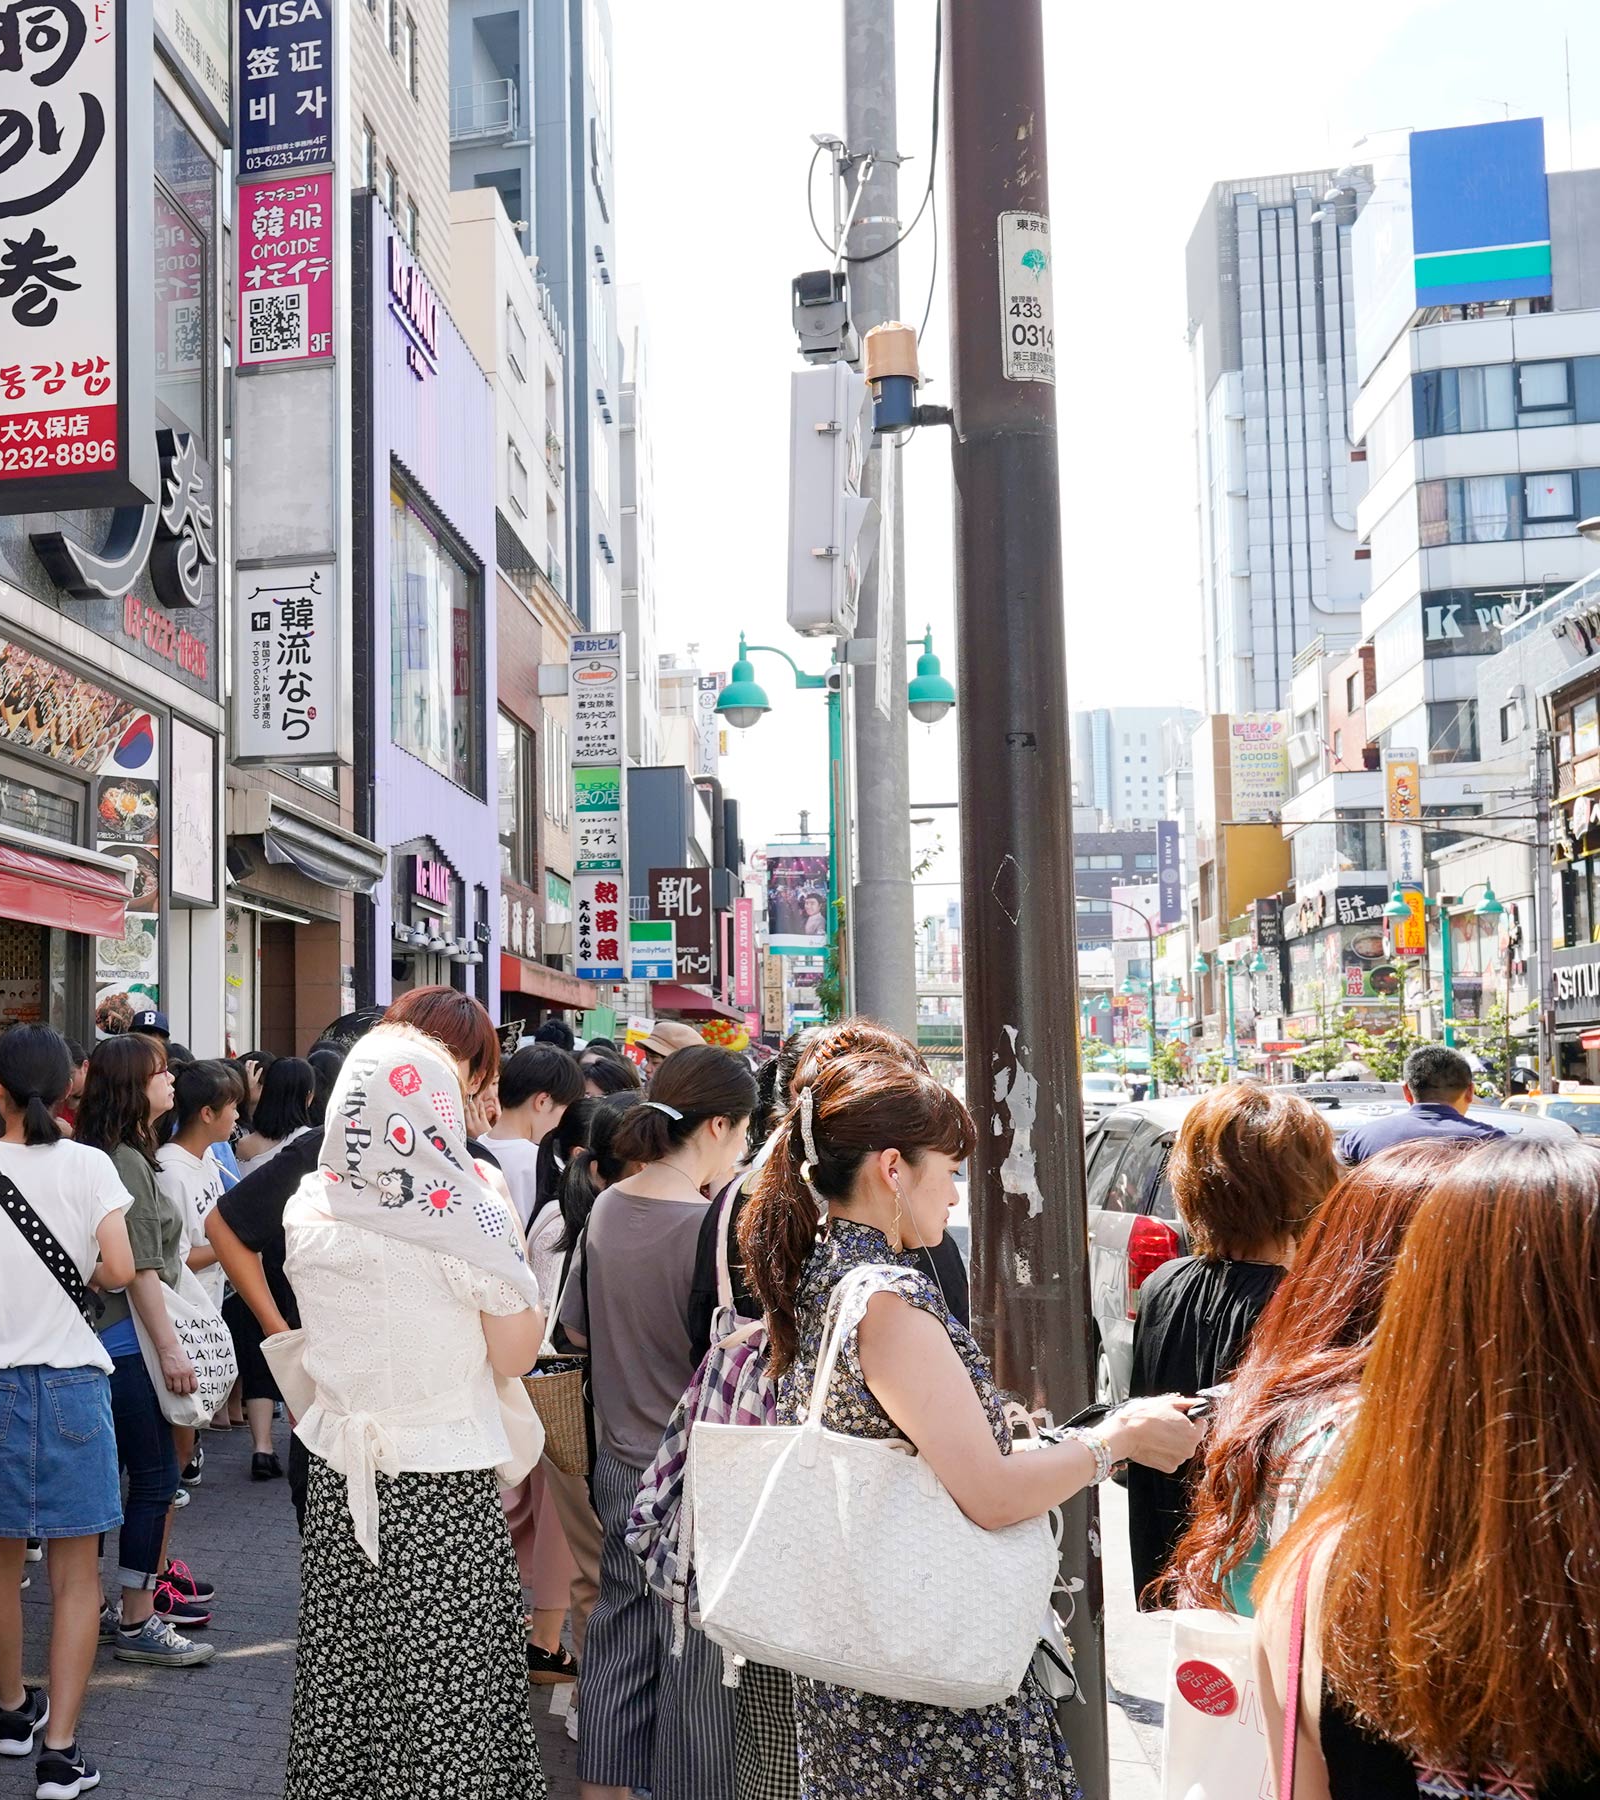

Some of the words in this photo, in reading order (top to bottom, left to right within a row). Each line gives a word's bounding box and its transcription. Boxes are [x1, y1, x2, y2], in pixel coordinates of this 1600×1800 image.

[245, 0, 322, 30] VISA
[246, 147, 327, 169] 03-6233-4777
[254, 184, 319, 204] チマチョゴリ
[251, 203, 323, 240] 韓服
[251, 237, 321, 260] OMOIDE
[244, 257, 332, 289] オモイデ
[1009, 303, 1042, 319] 433
[310, 332, 331, 353] 3F
[1011, 324, 1054, 350] 0314
[253, 614, 269, 629] 1F
[1425, 604, 1465, 641] K
[252, 641, 261, 667] K-pop
[274, 597, 314, 741] 韓流なら
[252, 668, 261, 697] Goods
[261, 640, 271, 729] 韓国アイドル関連商品
[701, 678, 715, 689] 5F
[252, 697, 261, 720] Shop
[585, 721, 608, 730] ライズ
[1240, 752, 1279, 761] GOODS
[575, 789, 620, 806] 愛の店
[579, 834, 618, 846] ライズ
[579, 861, 595, 869] 2F
[657, 876, 703, 917] 靴
[1337, 895, 1366, 911] 日本
[739, 910, 748, 948] LOVELY
[631, 946, 671, 956] FamilyMart
[739, 952, 748, 987] COSME
[143, 1011, 157, 1026] B
[1201, 1677, 1229, 1697] JAPAN
[1193, 1696, 1210, 1708] The
[1204, 1700, 1229, 1715] Origin
